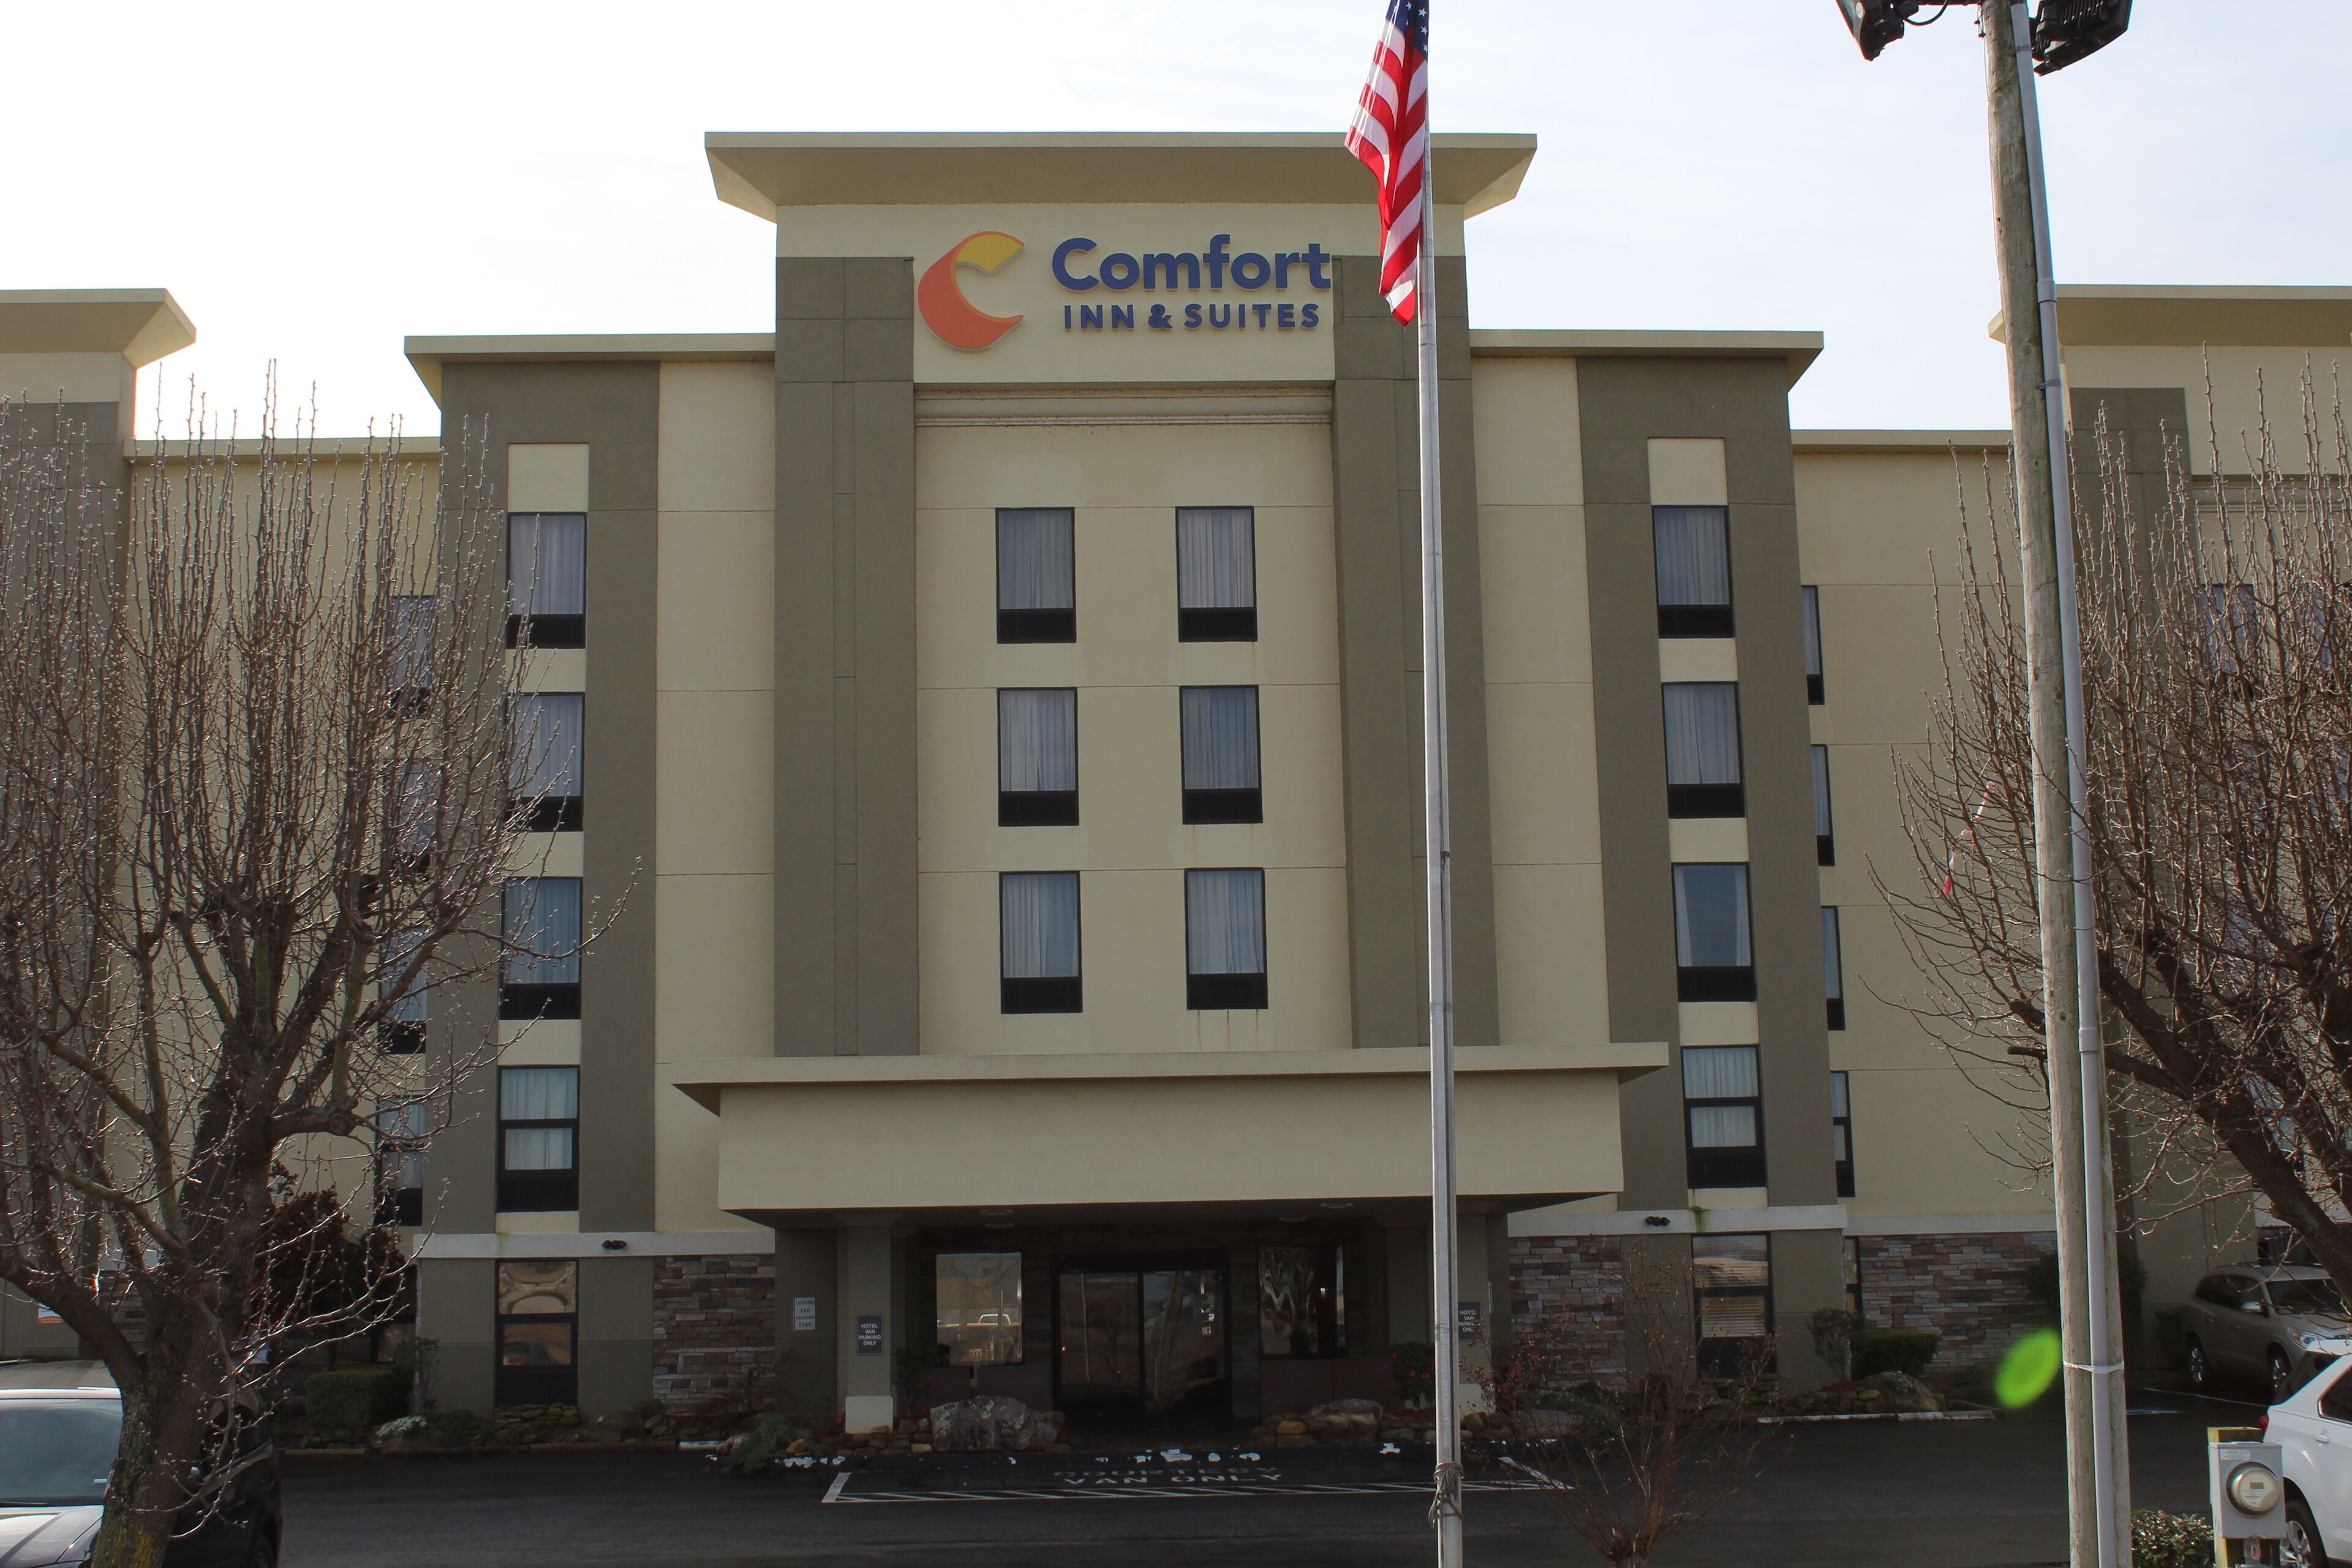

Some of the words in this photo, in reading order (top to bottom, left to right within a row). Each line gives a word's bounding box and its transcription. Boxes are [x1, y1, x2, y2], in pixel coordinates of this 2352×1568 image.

[1052, 234, 1331, 290] Comfort
[1064, 304, 1135, 330] INN
[1148, 304, 1172, 330] &
[1184, 303, 1319, 329] SUITES
[1171, 1474, 1282, 1483] ONLY
